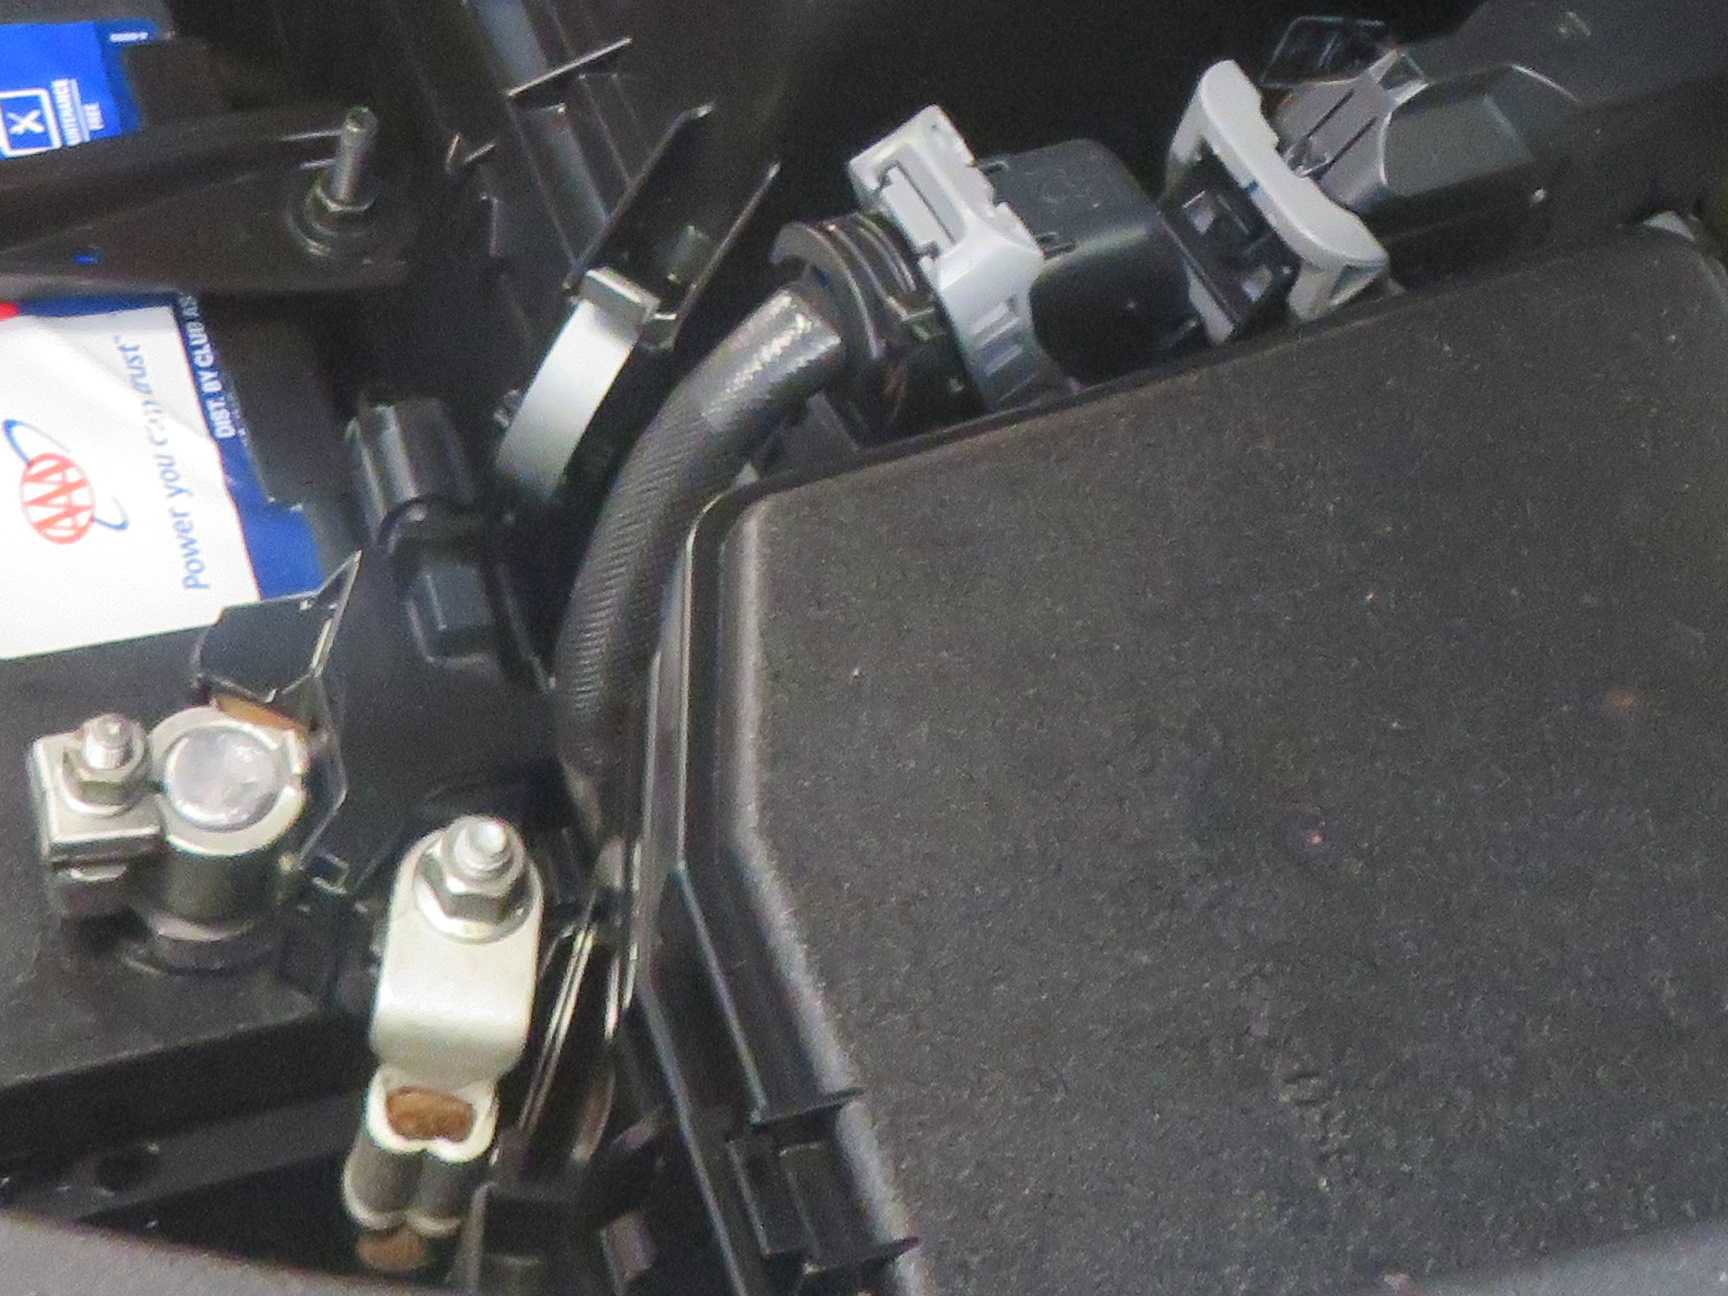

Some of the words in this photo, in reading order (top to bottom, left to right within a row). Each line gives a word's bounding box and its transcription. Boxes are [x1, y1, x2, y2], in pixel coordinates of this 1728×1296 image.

[185, 321, 215, 367] CLUB
[197, 370, 222, 392] BY
[23, 451, 96, 545] AAA
[154, 450, 194, 503] you
[170, 507, 211, 591] Power
